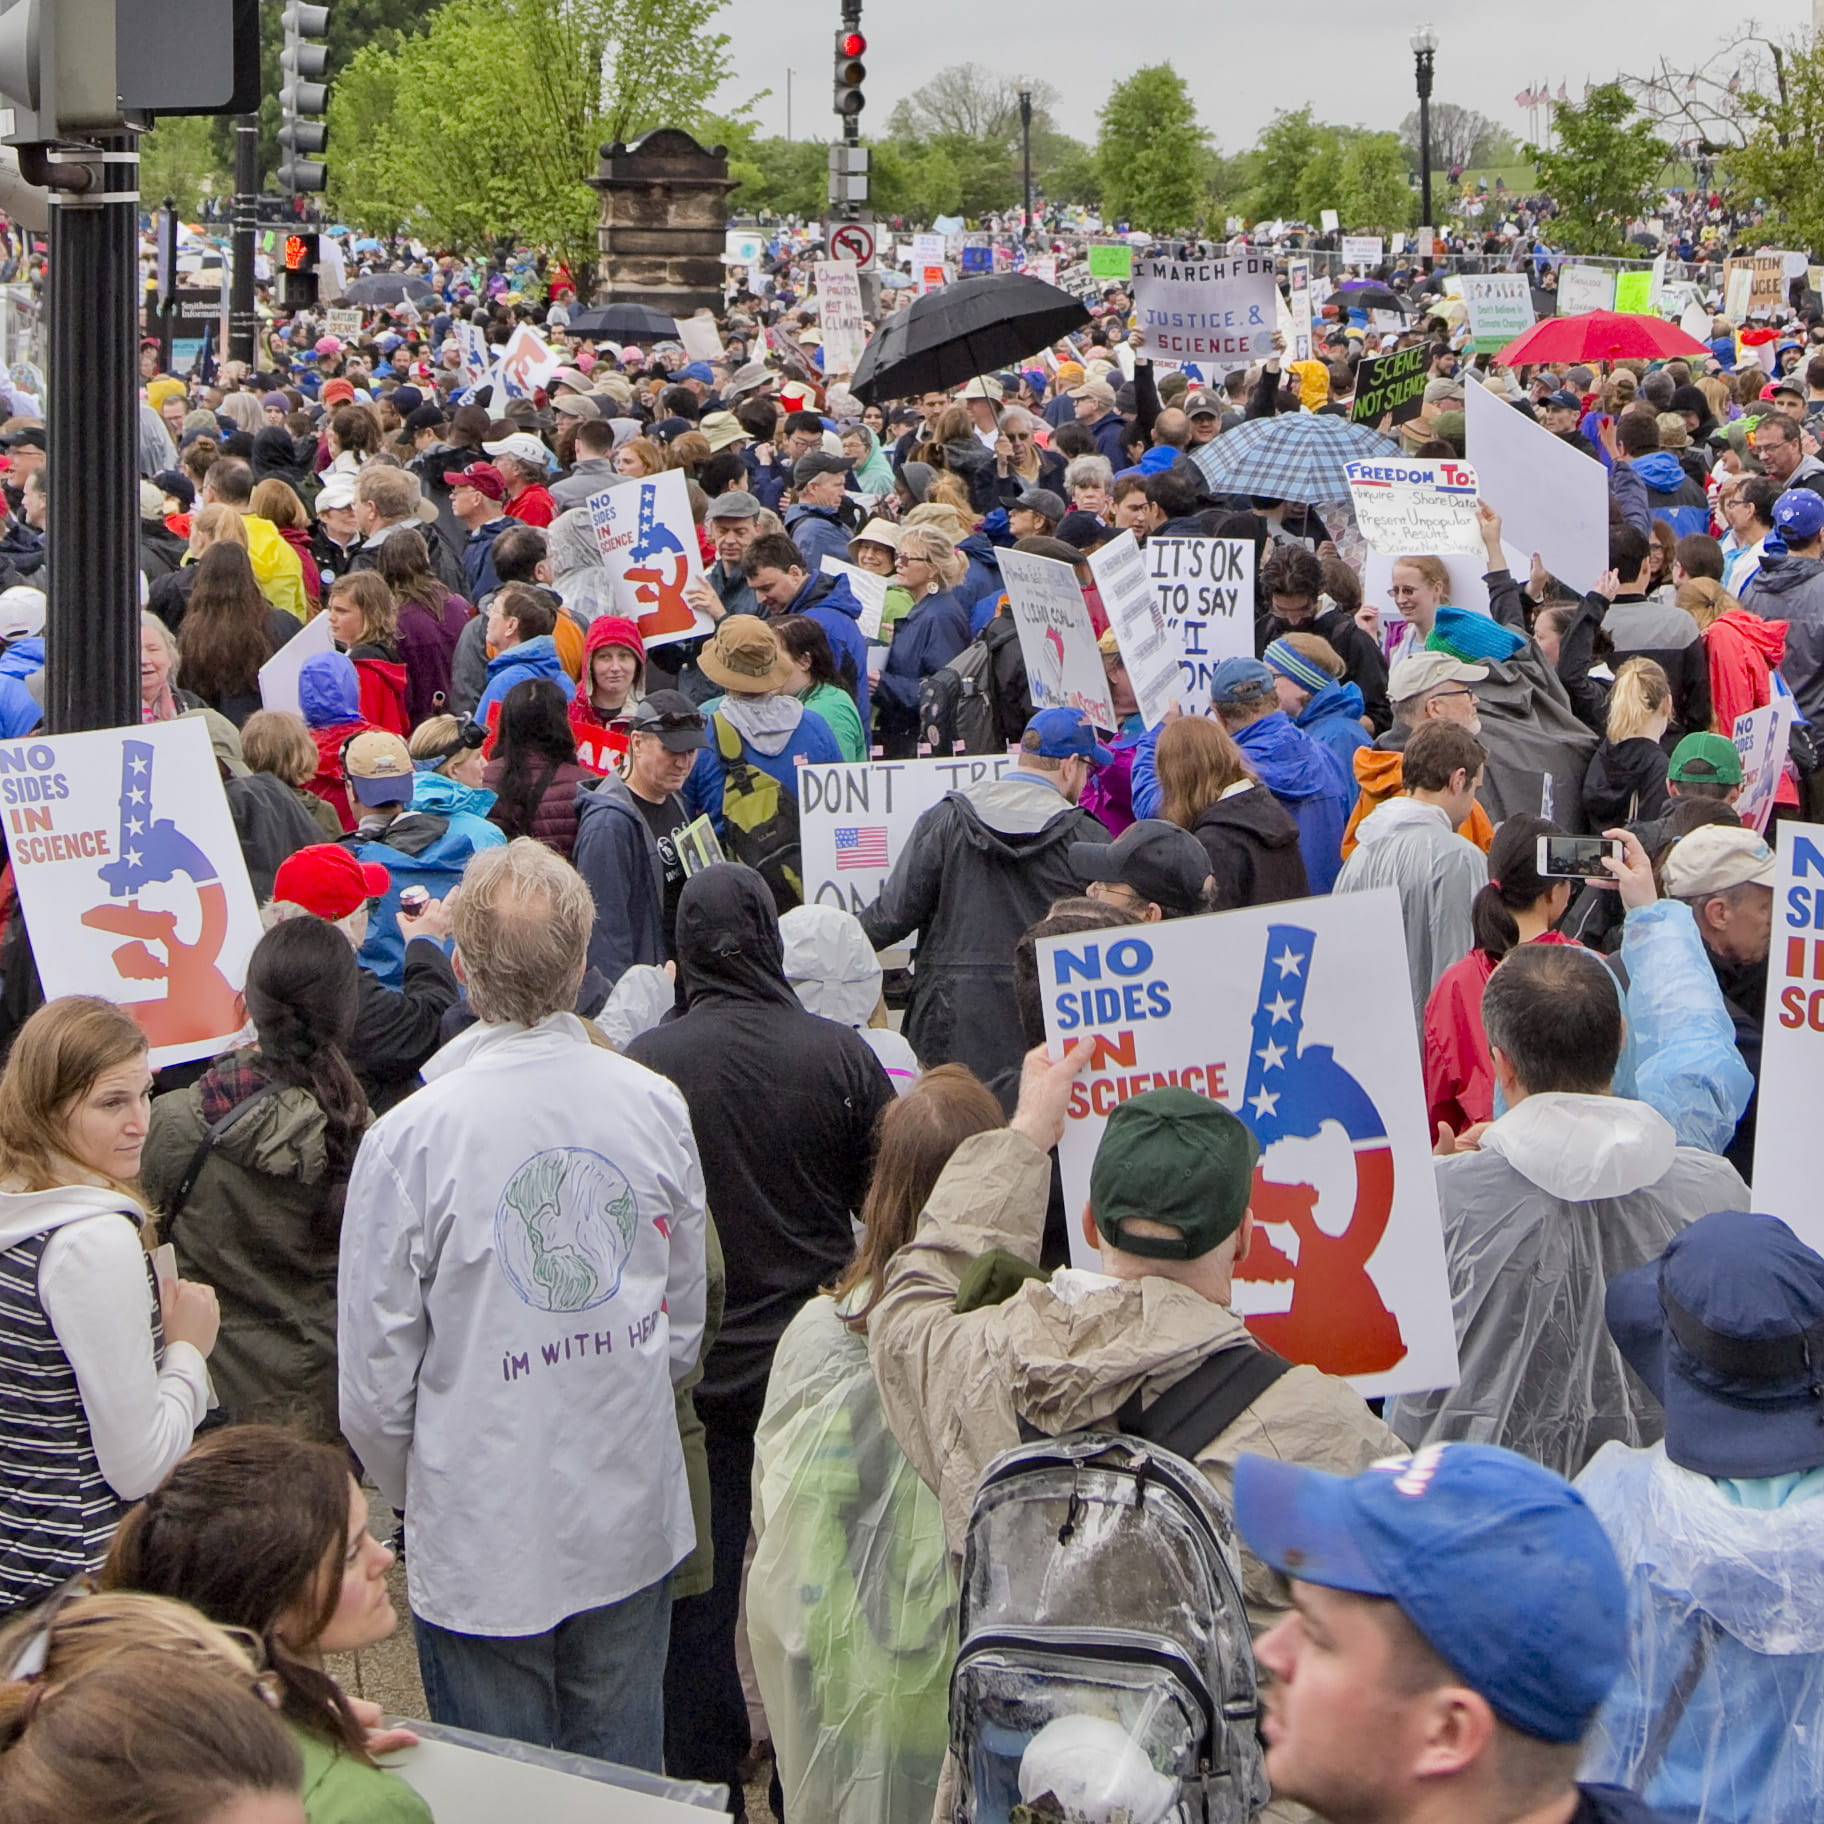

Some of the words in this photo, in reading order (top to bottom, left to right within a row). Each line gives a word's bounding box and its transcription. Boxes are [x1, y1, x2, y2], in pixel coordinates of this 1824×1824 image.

[1133, 262, 1146, 277] I
[1152, 262, 1226, 283] MARCH
[1231, 258, 1275, 277] FOR
[1730, 255, 1782, 272] EINSTEIN
[1751, 278, 1783, 296] UGEE
[331, 312, 359, 321] NATURE
[825, 317, 863, 332] CLIMATE
[1247, 304, 1264, 326] &
[1157, 334, 1251, 355] SCIENCE
[1155, 360, 1178, 370] CIENCE
[1369, 345, 1426, 387] SCIENCE
[1352, 388, 1384, 422] NOT
[1383, 371, 1428, 412] SILENCE
[1346, 462, 1436, 486] FREEDOM
[1440, 463, 1476, 487] To:
[590, 495, 611, 512] NO
[593, 508, 617, 527] SIDES
[1361, 509, 1407, 527] Present
[1407, 508, 1474, 530] Unpopular
[597, 525, 612, 540] IN
[600, 531, 635, 556] SCIENCE
[1402, 527, 1449, 541] Results
[1151, 540, 1204, 579] IT'S
[1209, 539, 1245, 582] OK
[1157, 584, 1193, 616] TO
[1196, 586, 1239, 618] SAY
[1736, 716, 1755, 735] NO
[3, 773, 70, 804] SIDES
[801, 766, 906, 816] DON'T
[935, 759, 1011, 789] TRE
[9, 805, 55, 835] IN
[15, 828, 112, 865] SCIENCE
[1052, 937, 1155, 985] NO
[1055, 980, 1173, 1030] SIDES
[1061, 1029, 1137, 1072] IN
[540, 1332, 613, 1368] WITH
